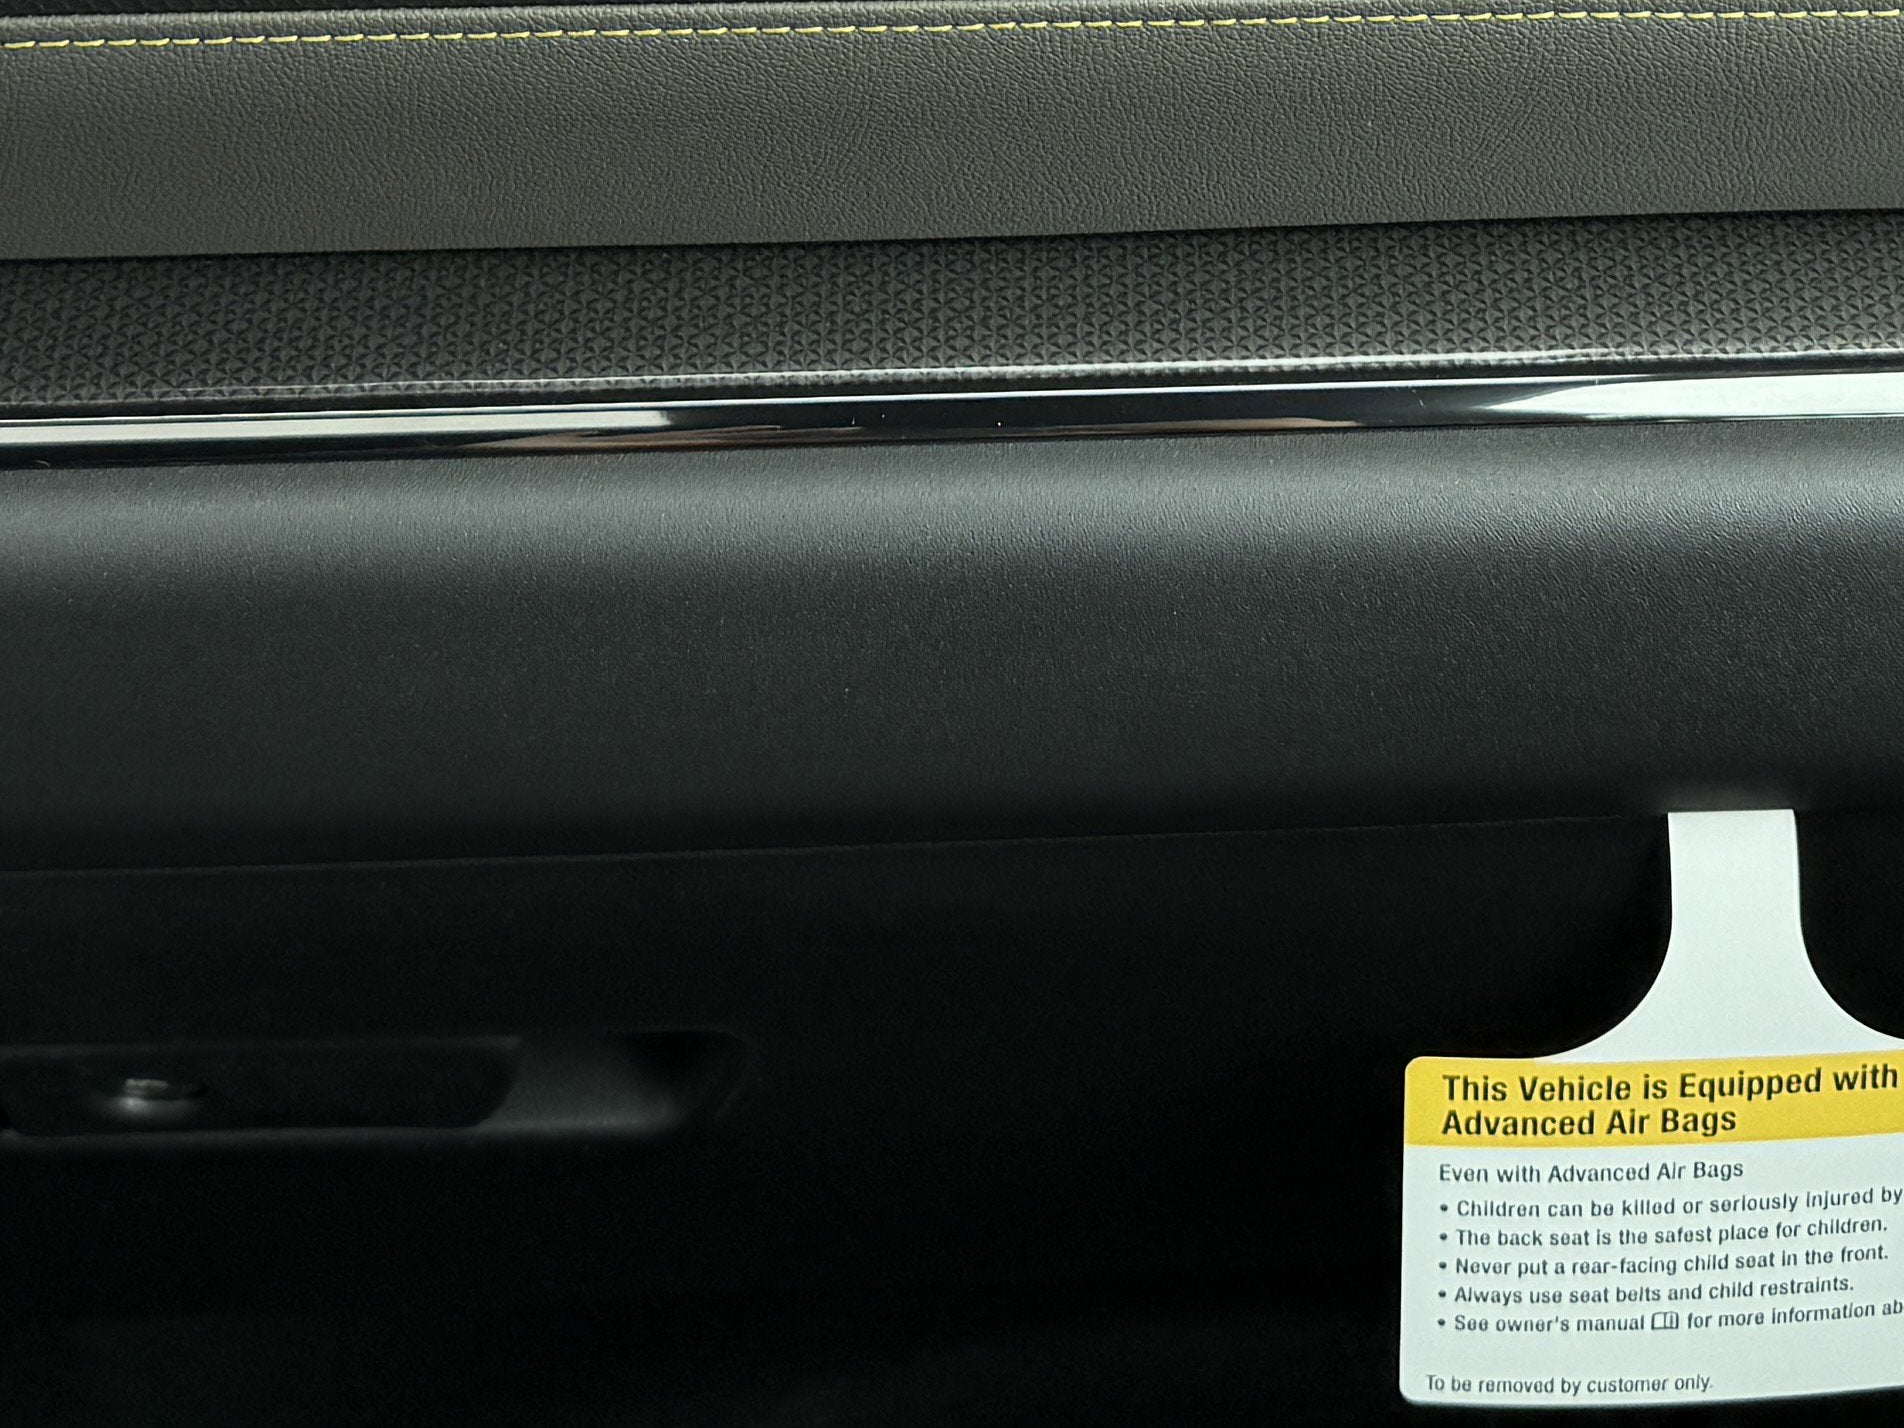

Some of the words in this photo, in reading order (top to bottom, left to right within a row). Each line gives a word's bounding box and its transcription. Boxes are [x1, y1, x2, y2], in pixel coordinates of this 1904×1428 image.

[1442, 1074, 1508, 1102] This
[1519, 1074, 1632, 1101] Vehicle
[1643, 1073, 1669, 1100] is
[1680, 1067, 1822, 1103] Equipped
[1833, 1063, 1898, 1092] with
[1442, 1109, 1595, 1136] Advanced
[1606, 1108, 1650, 1135] Air
[1661, 1108, 1737, 1138] Bags
[1439, 1163, 1489, 1183] Even
[1497, 1164, 1541, 1184] with
[1548, 1162, 1650, 1184] Advanced
[1657, 1161, 1686, 1181] Air
[1693, 1161, 1744, 1182] Bags
[1457, 1200, 1540, 1218] Children
[1548, 1203, 1583, 1218] can
[1591, 1199, 1614, 1217] be
[1622, 1197, 1676, 1216] killed
[1683, 1200, 1703, 1215] or
[1709, 1192, 1799, 1215] seriously
[1806, 1187, 1874, 1211] injured
[1881, 1185, 1903, 1206] by
[1456, 1229, 1491, 1246] The
[1498, 1228, 1543, 1246] back
[1549, 1230, 1590, 1246] seat
[1596, 1228, 1612, 1245] is
[1619, 1227, 1648, 1245] the
[1654, 1225, 1713, 1244] safest
[1719, 1224, 1770, 1245] place
[1776, 1221, 1801, 1238] for
[1807, 1217, 1889, 1237] children.
[1456, 1258, 1512, 1275] Never
[1518, 1260, 1549, 1279] put
[1554, 1261, 1566, 1275] a
[1572, 1255, 1678, 1276] rear-facing
[1684, 1253, 1730, 1272] child
[1735, 1252, 1776, 1270] seat
[1781, 1250, 1799, 1267] in
[1805, 1247, 1834, 1265] the
[1841, 1244, 1890, 1263] front.
[1454, 1286, 1523, 1307] Always
[1529, 1290, 1563, 1304] use
[1569, 1288, 1610, 1304] seat
[1616, 1285, 1662, 1304] belts
[1667, 1284, 1703, 1302] and
[1708, 1282, 1754, 1300] child
[1760, 1276, 1855, 1298] restraints.
[1454, 1315, 1490, 1332] See
[1496, 1316, 1570, 1333] owner's
[1577, 1313, 1645, 1332] manual
[1687, 1312, 1713, 1330] for
[1718, 1311, 1766, 1328] more
[1771, 1301, 1876, 1326] information
[1426, 1375, 1445, 1392] To
[1452, 1375, 1473, 1392] be
[1478, 1376, 1555, 1393] removed
[1561, 1378, 1582, 1396] by
[1587, 1377, 1669, 1393] customer
[1674, 1374, 1714, 1392] only.
